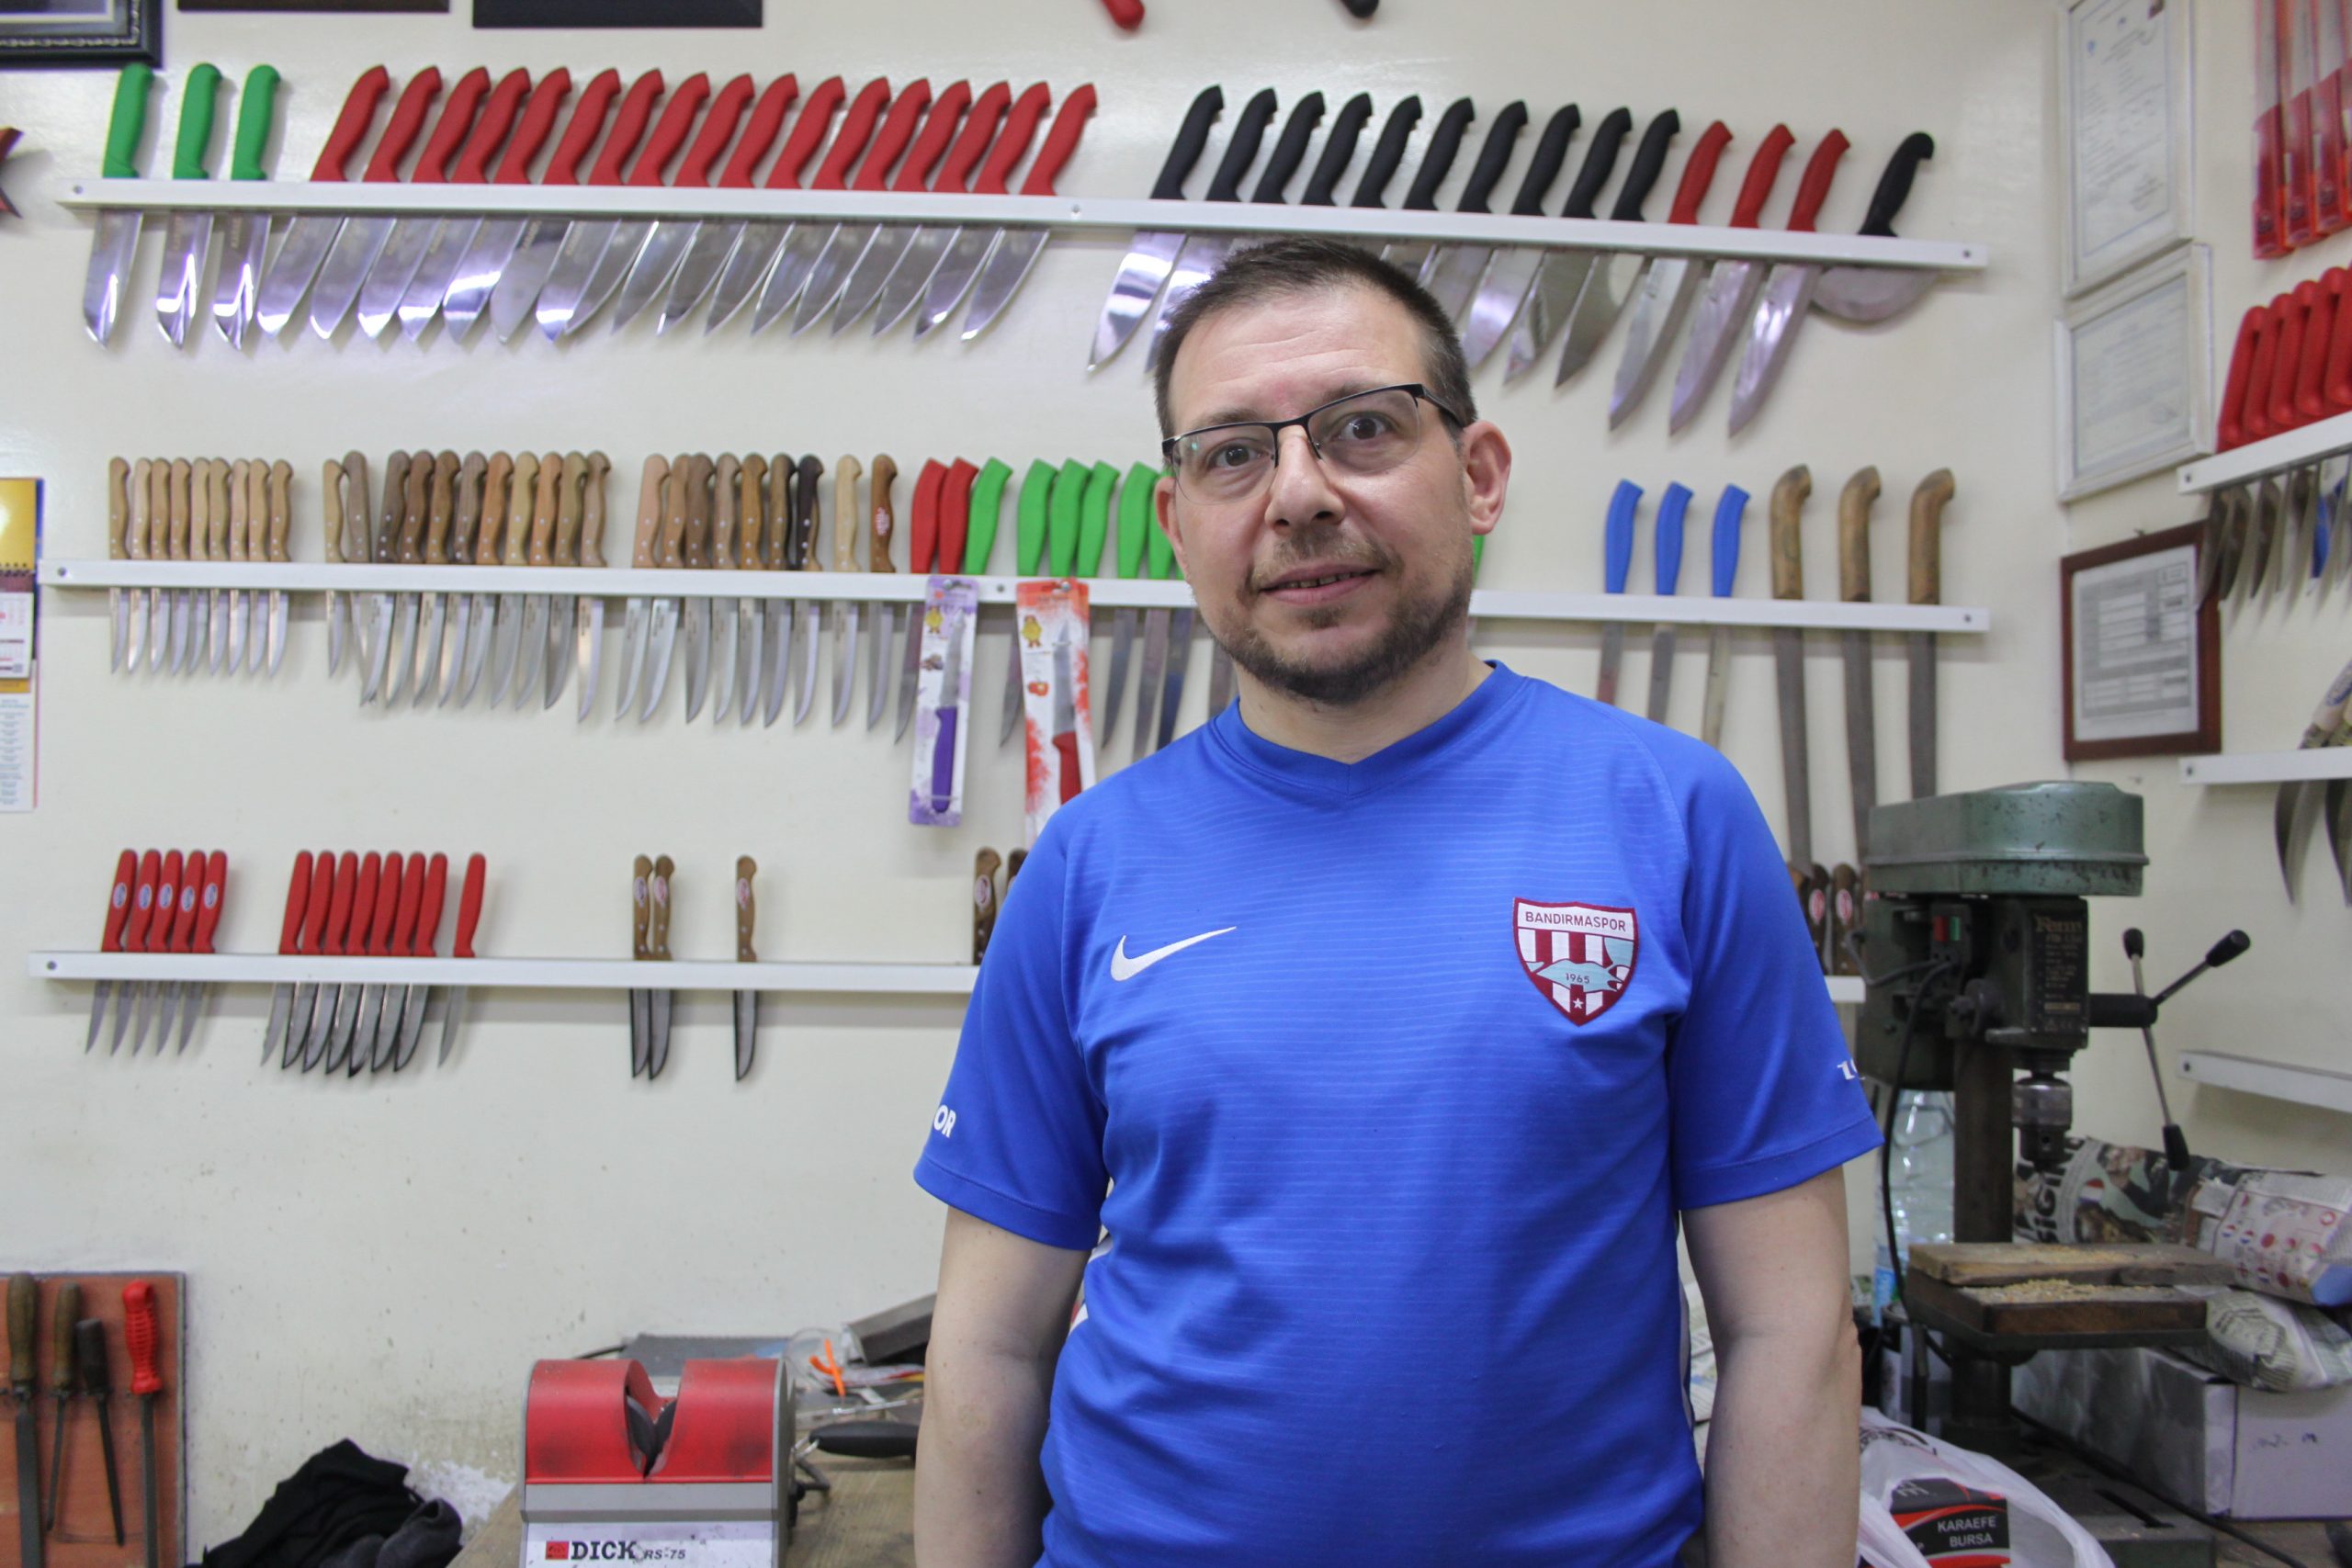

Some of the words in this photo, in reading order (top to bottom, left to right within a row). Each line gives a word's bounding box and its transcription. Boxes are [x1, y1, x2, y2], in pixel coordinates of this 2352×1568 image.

[1525, 910, 1626, 931] BANDIRMASPOR
[1566, 973, 1590, 985] 1965
[1937, 1515, 1997, 1533] KARAEFE
[1949, 1532, 1994, 1548] BURSA
[571, 1540, 638, 1560] DICK
[643, 1548, 686, 1560] RS-75
